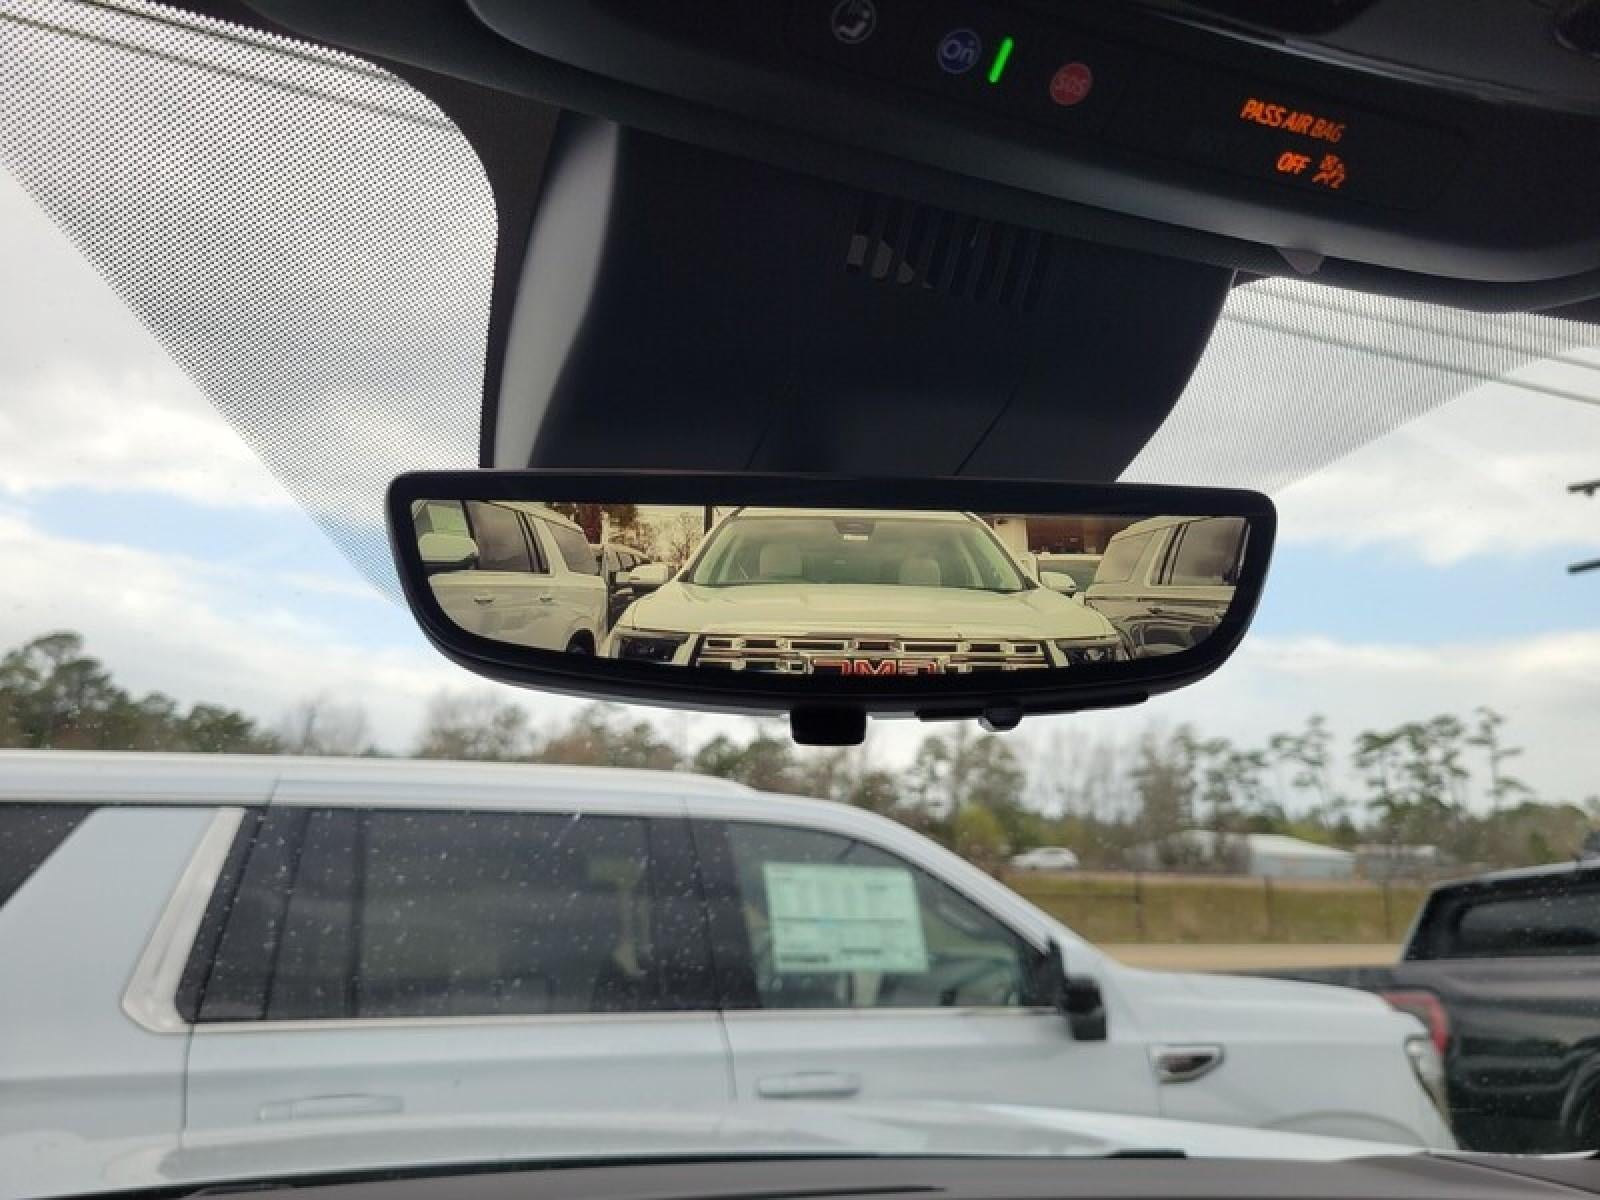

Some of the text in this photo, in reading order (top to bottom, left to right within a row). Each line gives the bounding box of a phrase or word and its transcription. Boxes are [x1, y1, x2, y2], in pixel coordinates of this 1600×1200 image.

[1053, 73, 1089, 96] SOS
[1240, 99, 1287, 126] PASS
[1277, 152, 1311, 174] OFF
